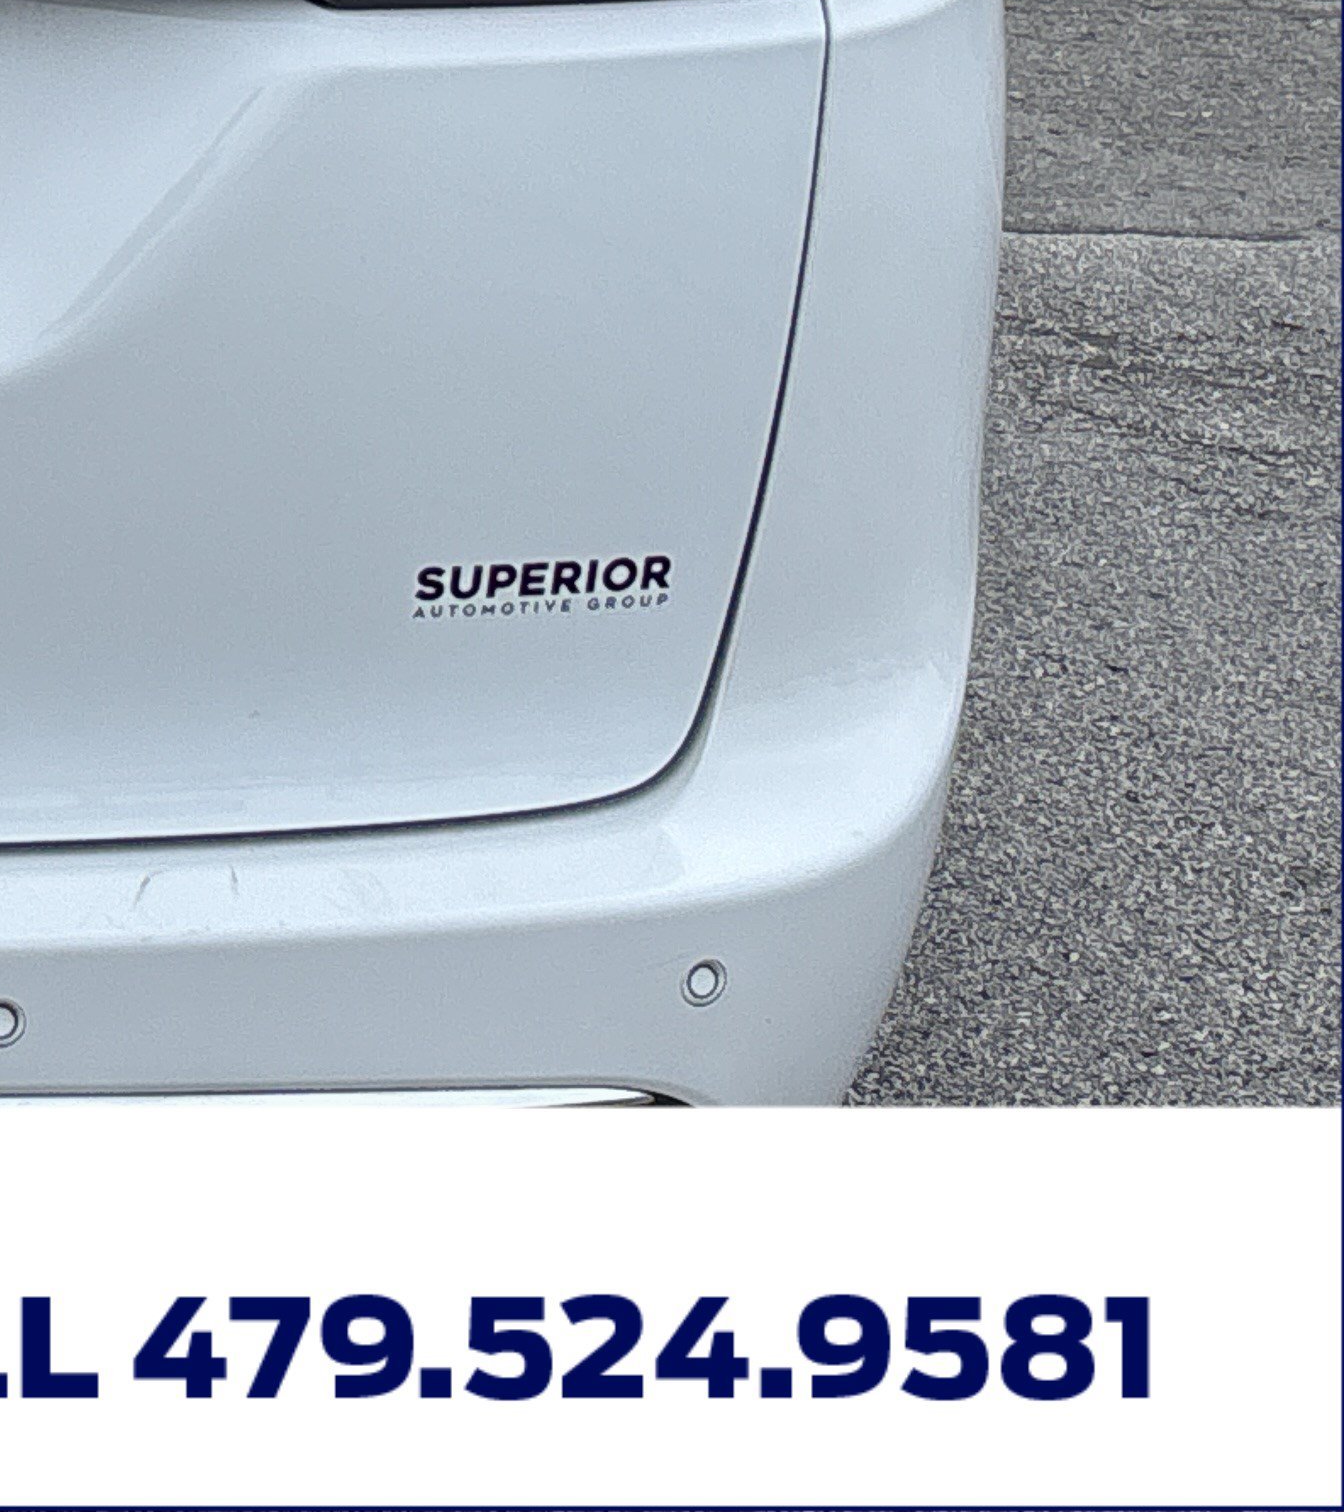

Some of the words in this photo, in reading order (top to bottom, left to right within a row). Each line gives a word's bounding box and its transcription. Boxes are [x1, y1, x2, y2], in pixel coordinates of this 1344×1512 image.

[414, 555, 672, 601] SUPERIOR
[412, 599, 572, 619] AUTOMOTIVE
[586, 592, 669, 611] GROUP
